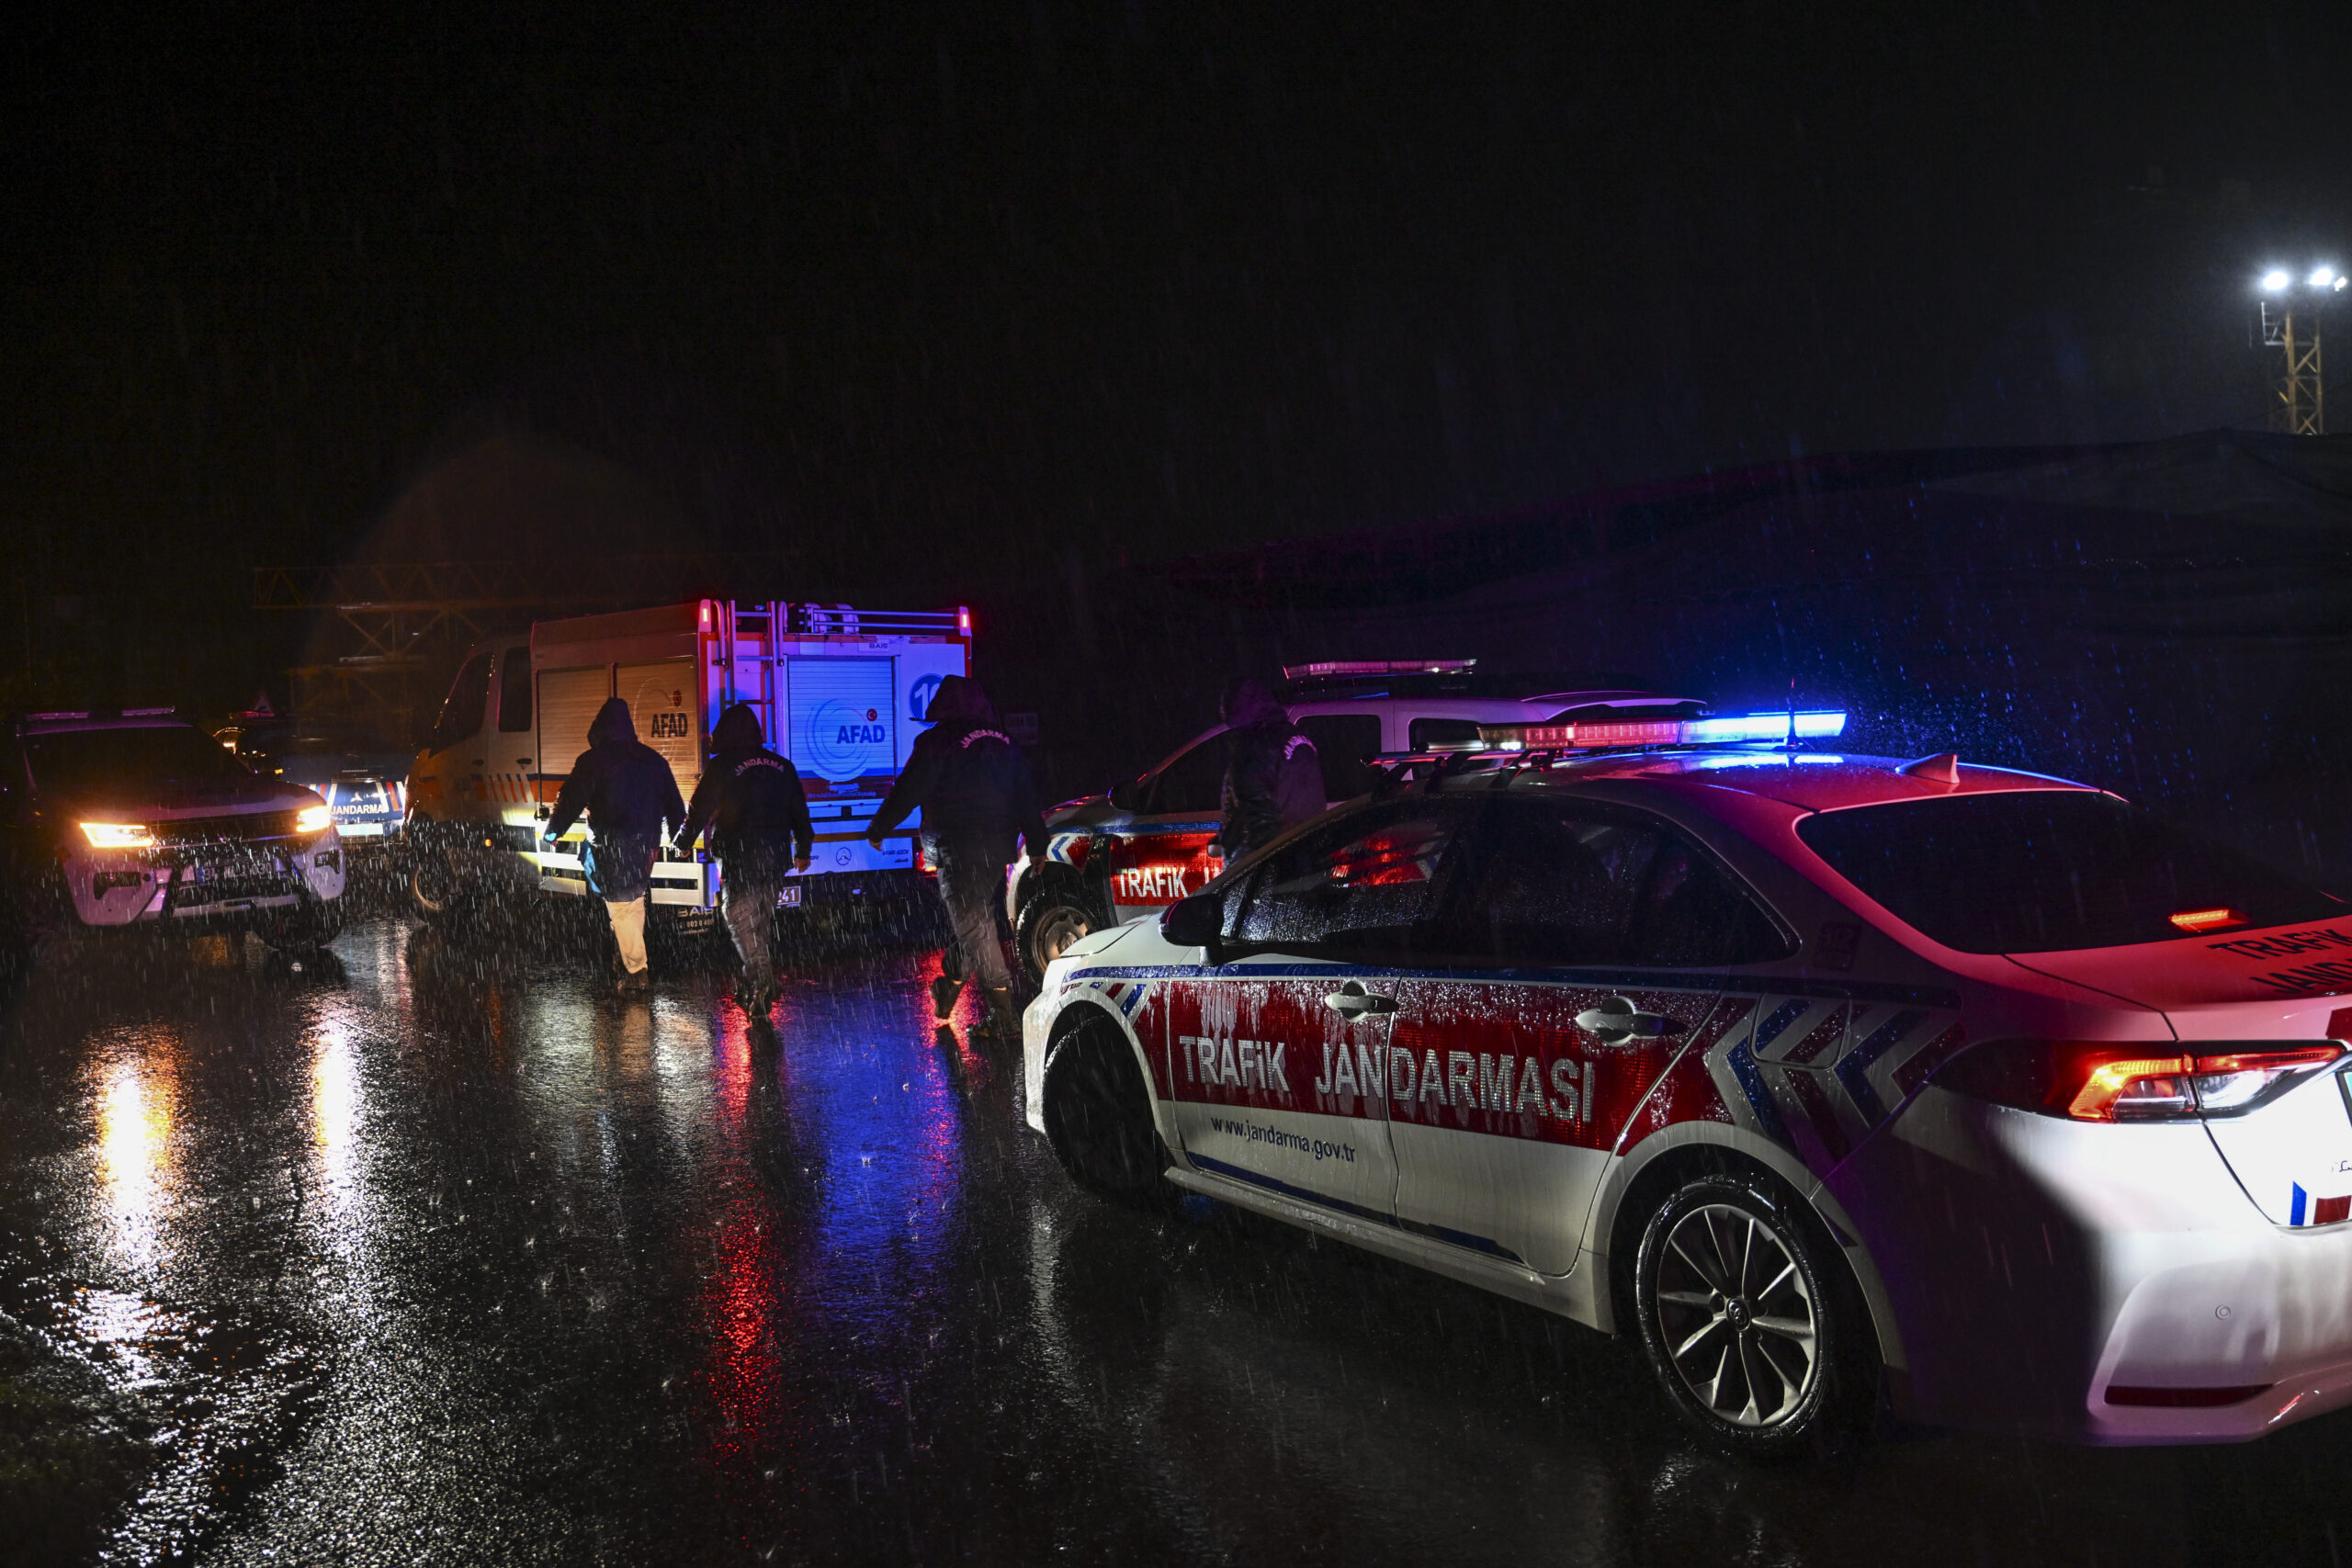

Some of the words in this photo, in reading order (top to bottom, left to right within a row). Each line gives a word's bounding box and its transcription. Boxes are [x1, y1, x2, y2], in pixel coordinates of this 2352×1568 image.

[651, 712, 688, 738] AFAD
[836, 725, 886, 744] AFAD
[735, 758, 784, 776] JANDARMA
[331, 804, 383, 815] JANDARMA
[1314, 1042, 1595, 1123] JANDARMASI
[1211, 1115, 1355, 1162] www.jandarma.gov.tr
